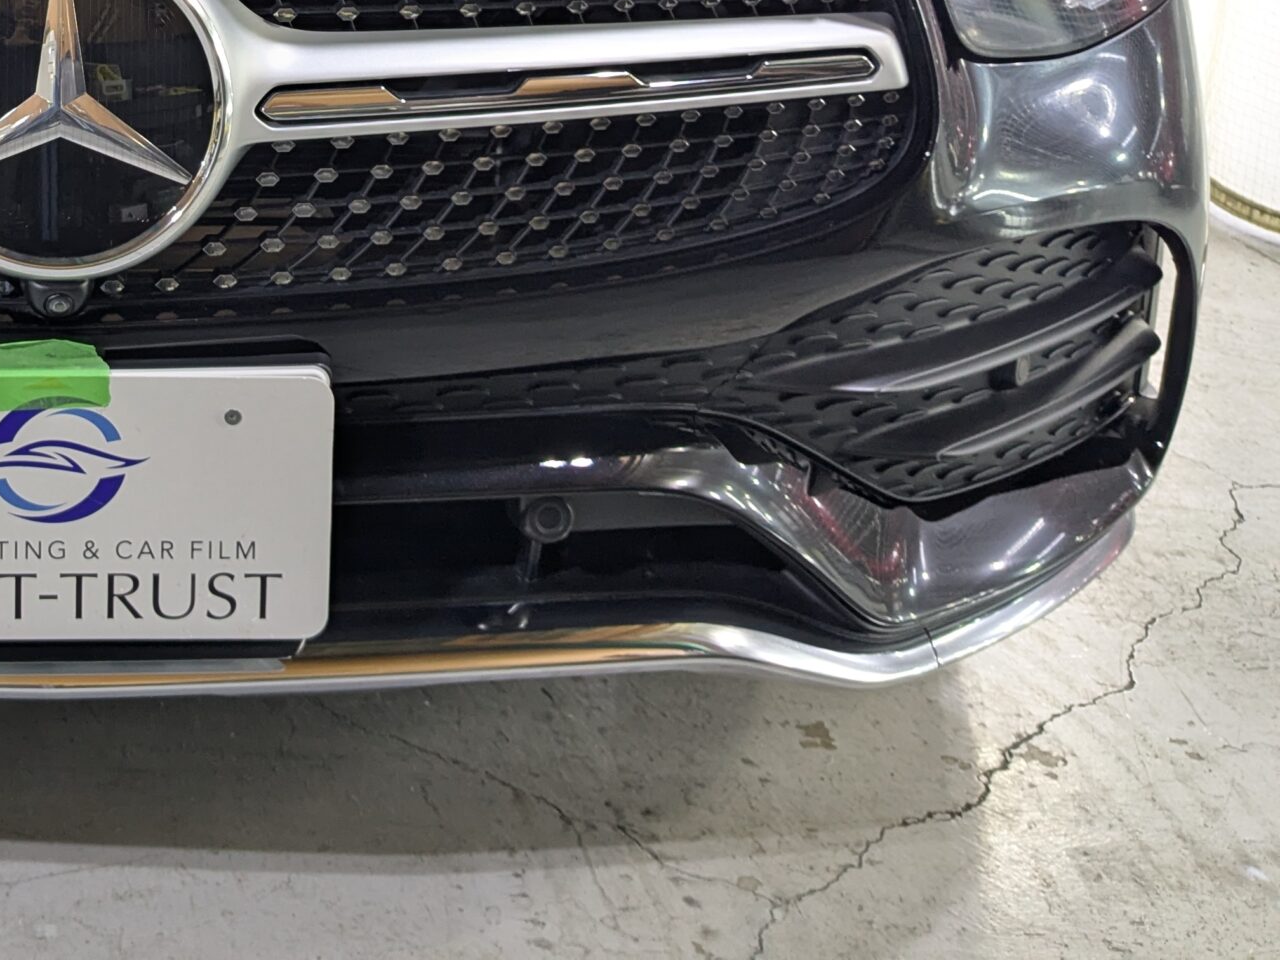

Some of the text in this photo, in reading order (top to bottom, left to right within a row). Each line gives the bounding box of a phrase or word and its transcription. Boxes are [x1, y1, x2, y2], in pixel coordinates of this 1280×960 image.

[82, 540, 100, 560] &
[115, 540, 174, 560] CAR
[190, 540, 256, 560] FILM
